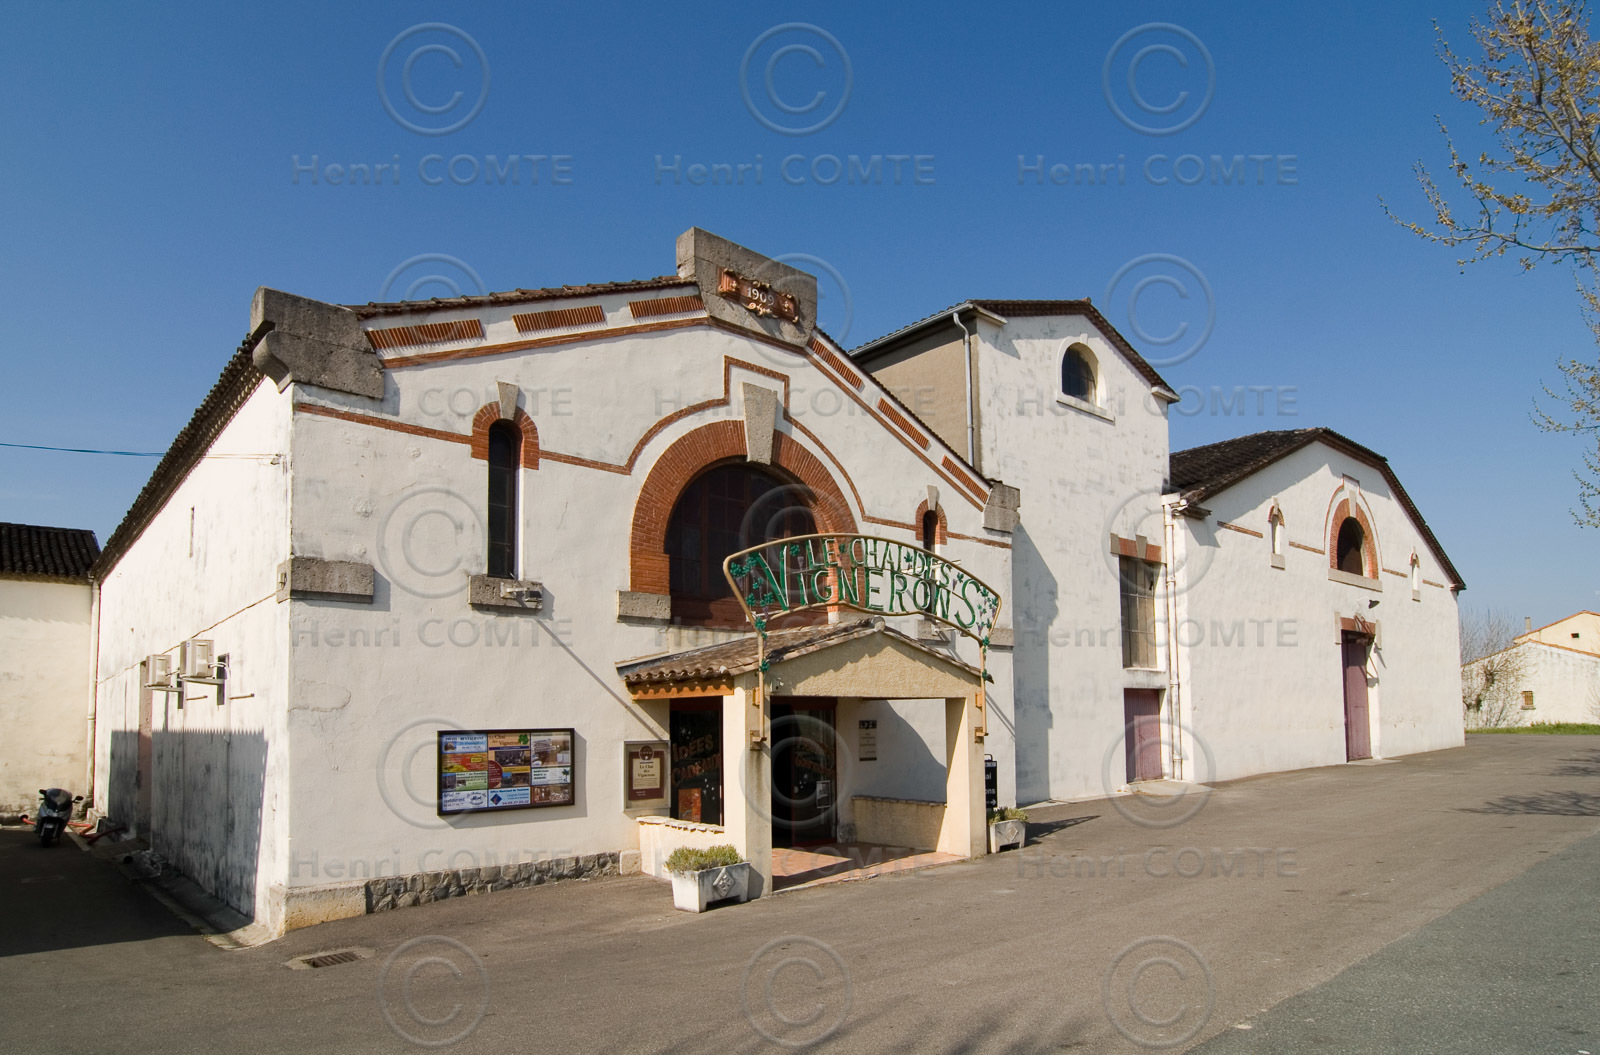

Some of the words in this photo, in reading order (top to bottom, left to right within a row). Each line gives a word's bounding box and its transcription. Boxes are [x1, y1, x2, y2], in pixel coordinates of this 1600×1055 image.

[754, 543, 981, 630] VIGNERONS
[806, 538, 839, 569] LE
[849, 537, 902, 572] CHAI
[912, 549, 952, 588] DES
